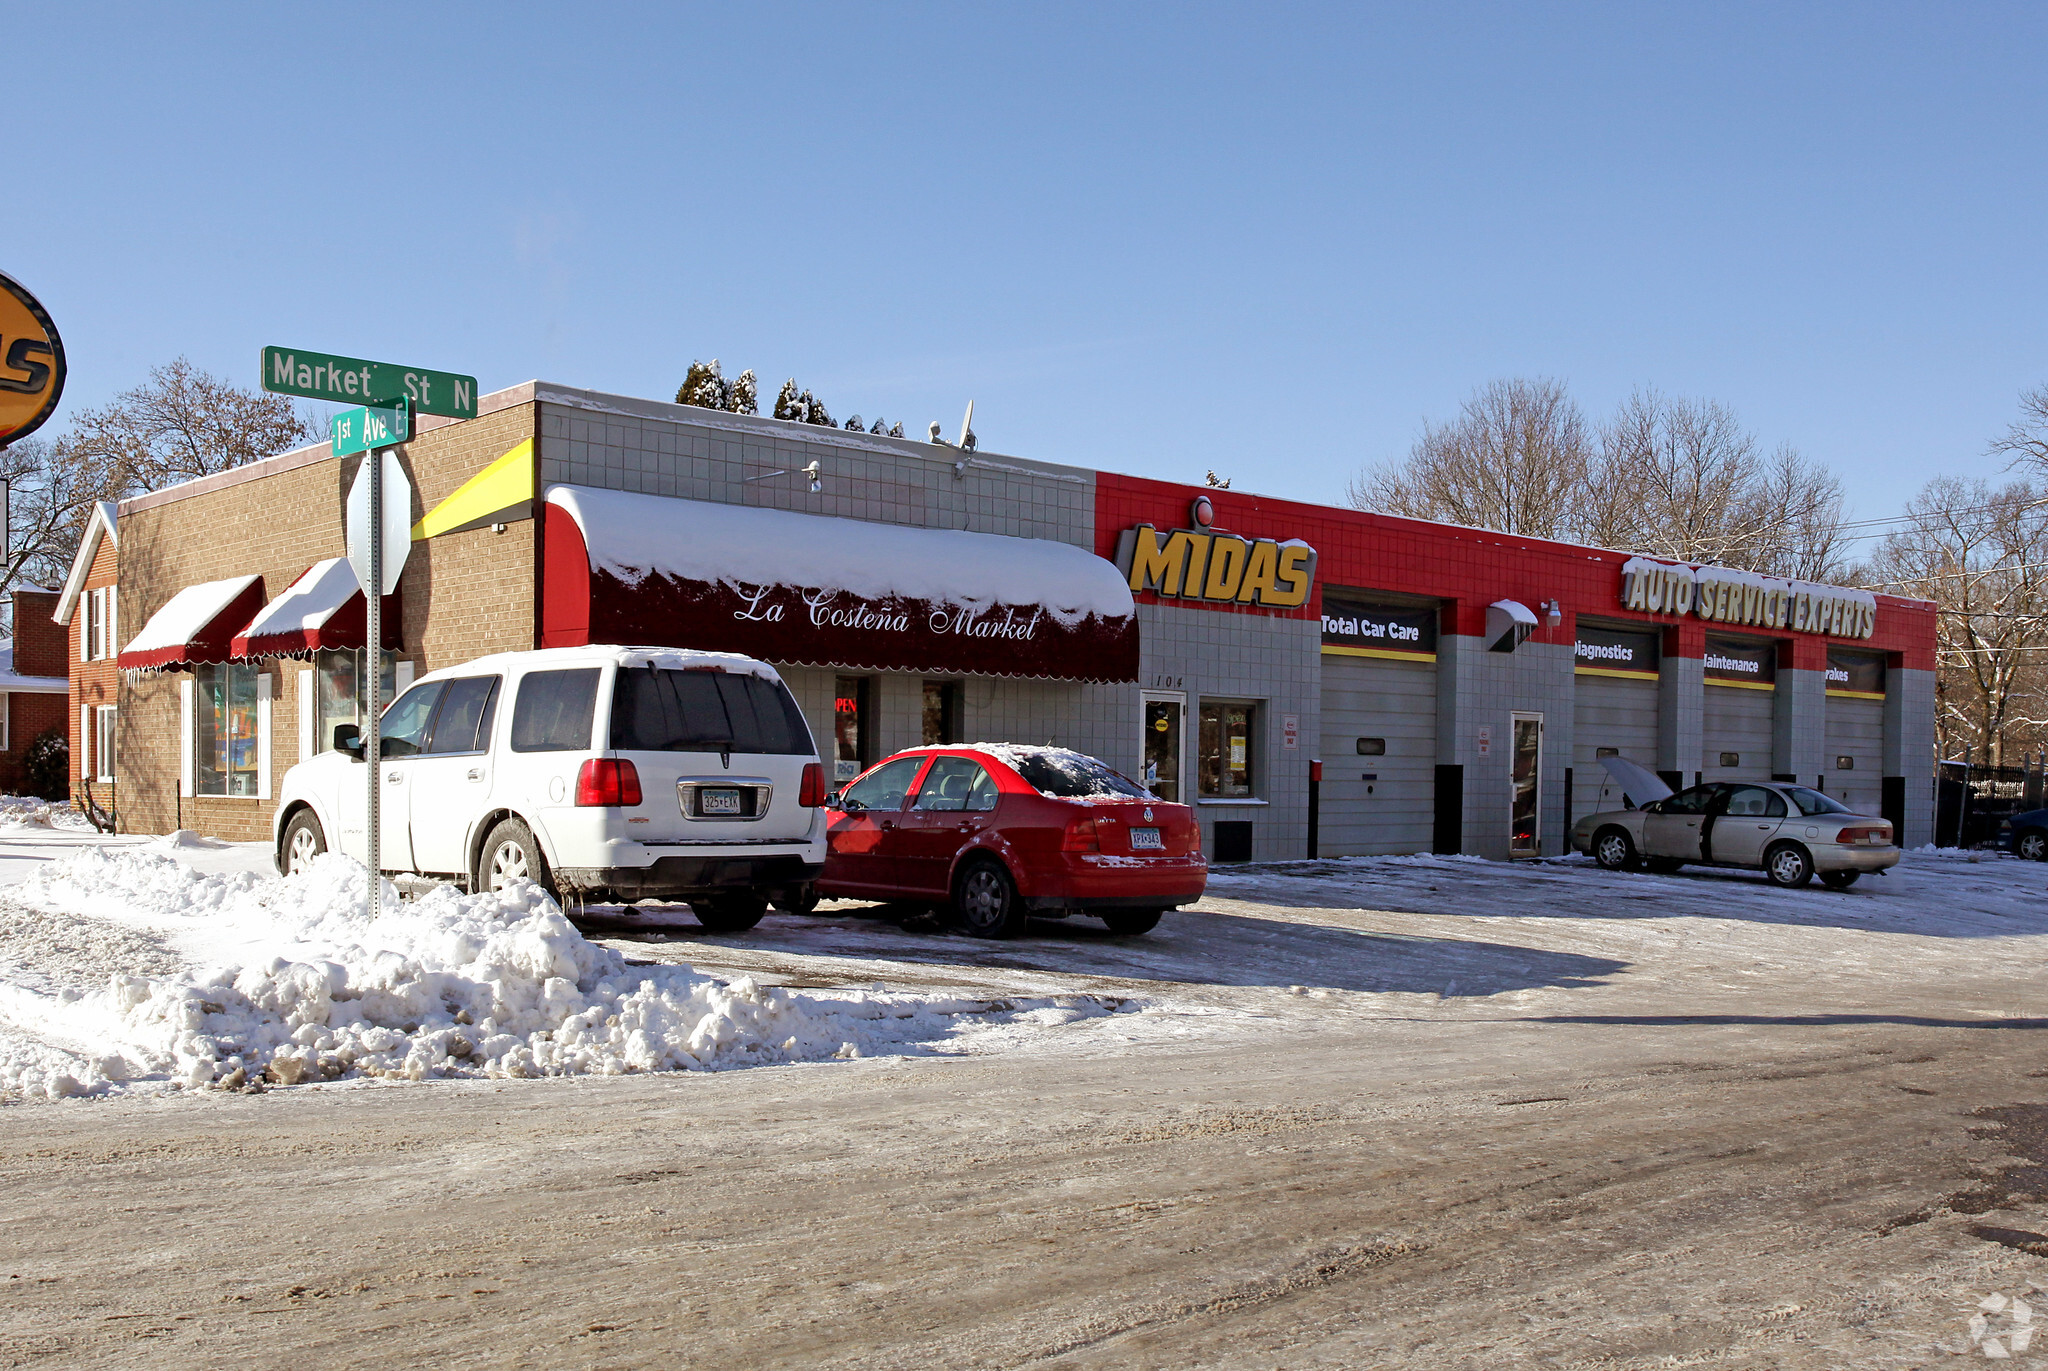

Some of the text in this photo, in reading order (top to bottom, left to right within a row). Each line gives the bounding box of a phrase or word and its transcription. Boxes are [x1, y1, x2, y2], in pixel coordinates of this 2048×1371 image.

[0, 338, 53, 394] S
[274, 352, 470, 411] Market St N
[337, 403, 404, 449] 1st Ave E
[1129, 527, 1309, 605] MIDAS
[734, 581, 1039, 641] La Costeña Market
[1627, 567, 1874, 640] AUTO SERVICE EXPERTS
[1320, 615, 1419, 641] Total Car Care
[1157, 675, 1183, 688] 104
[1825, 667, 1849, 682] rakes
[835, 698, 857, 712] PEN
[704, 796, 738, 808] 325 EXK
